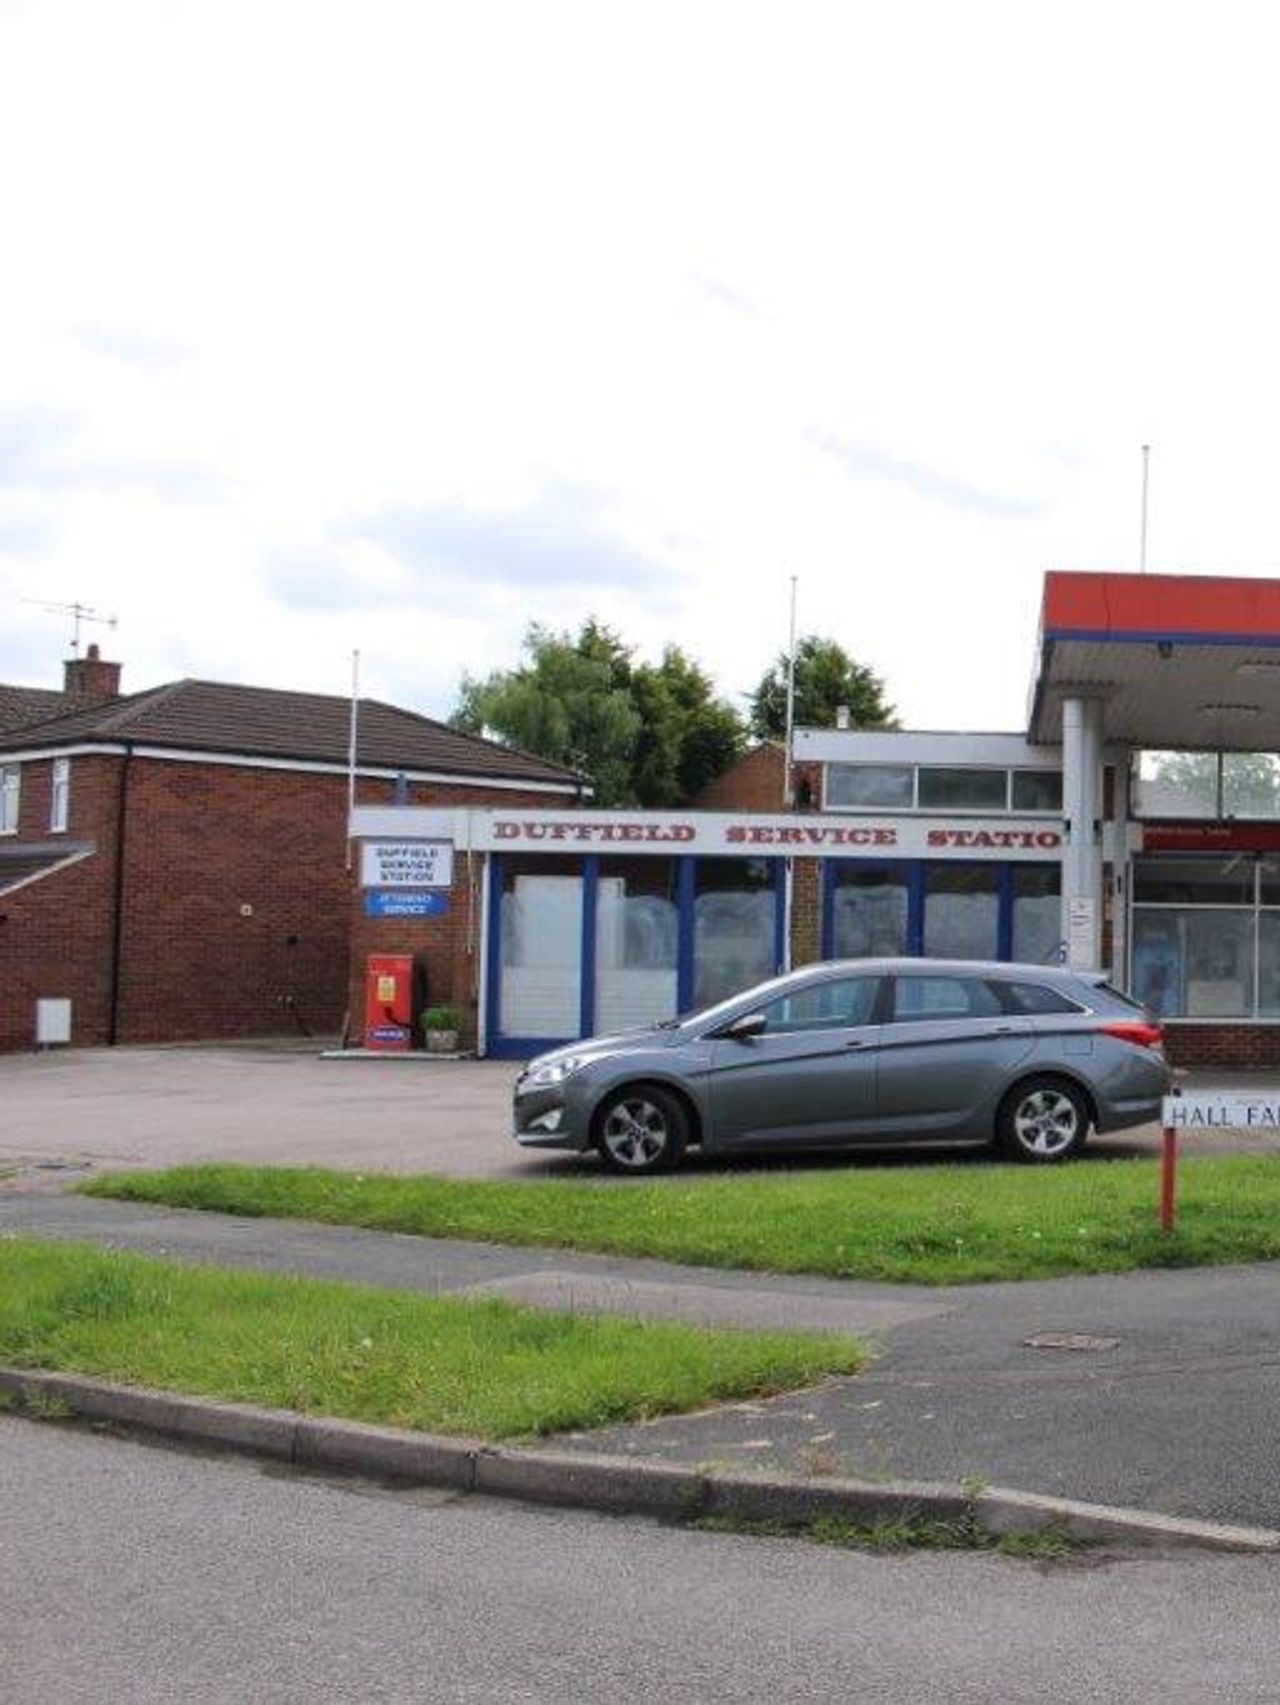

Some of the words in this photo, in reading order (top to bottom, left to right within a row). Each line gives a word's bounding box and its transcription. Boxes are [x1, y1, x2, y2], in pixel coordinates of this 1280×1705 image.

[493, 822, 696, 842] DUFFIELD
[725, 825, 897, 844] SERVICE
[927, 829, 1062, 848] STATIO
[1172, 1106, 1233, 1126] HALL
